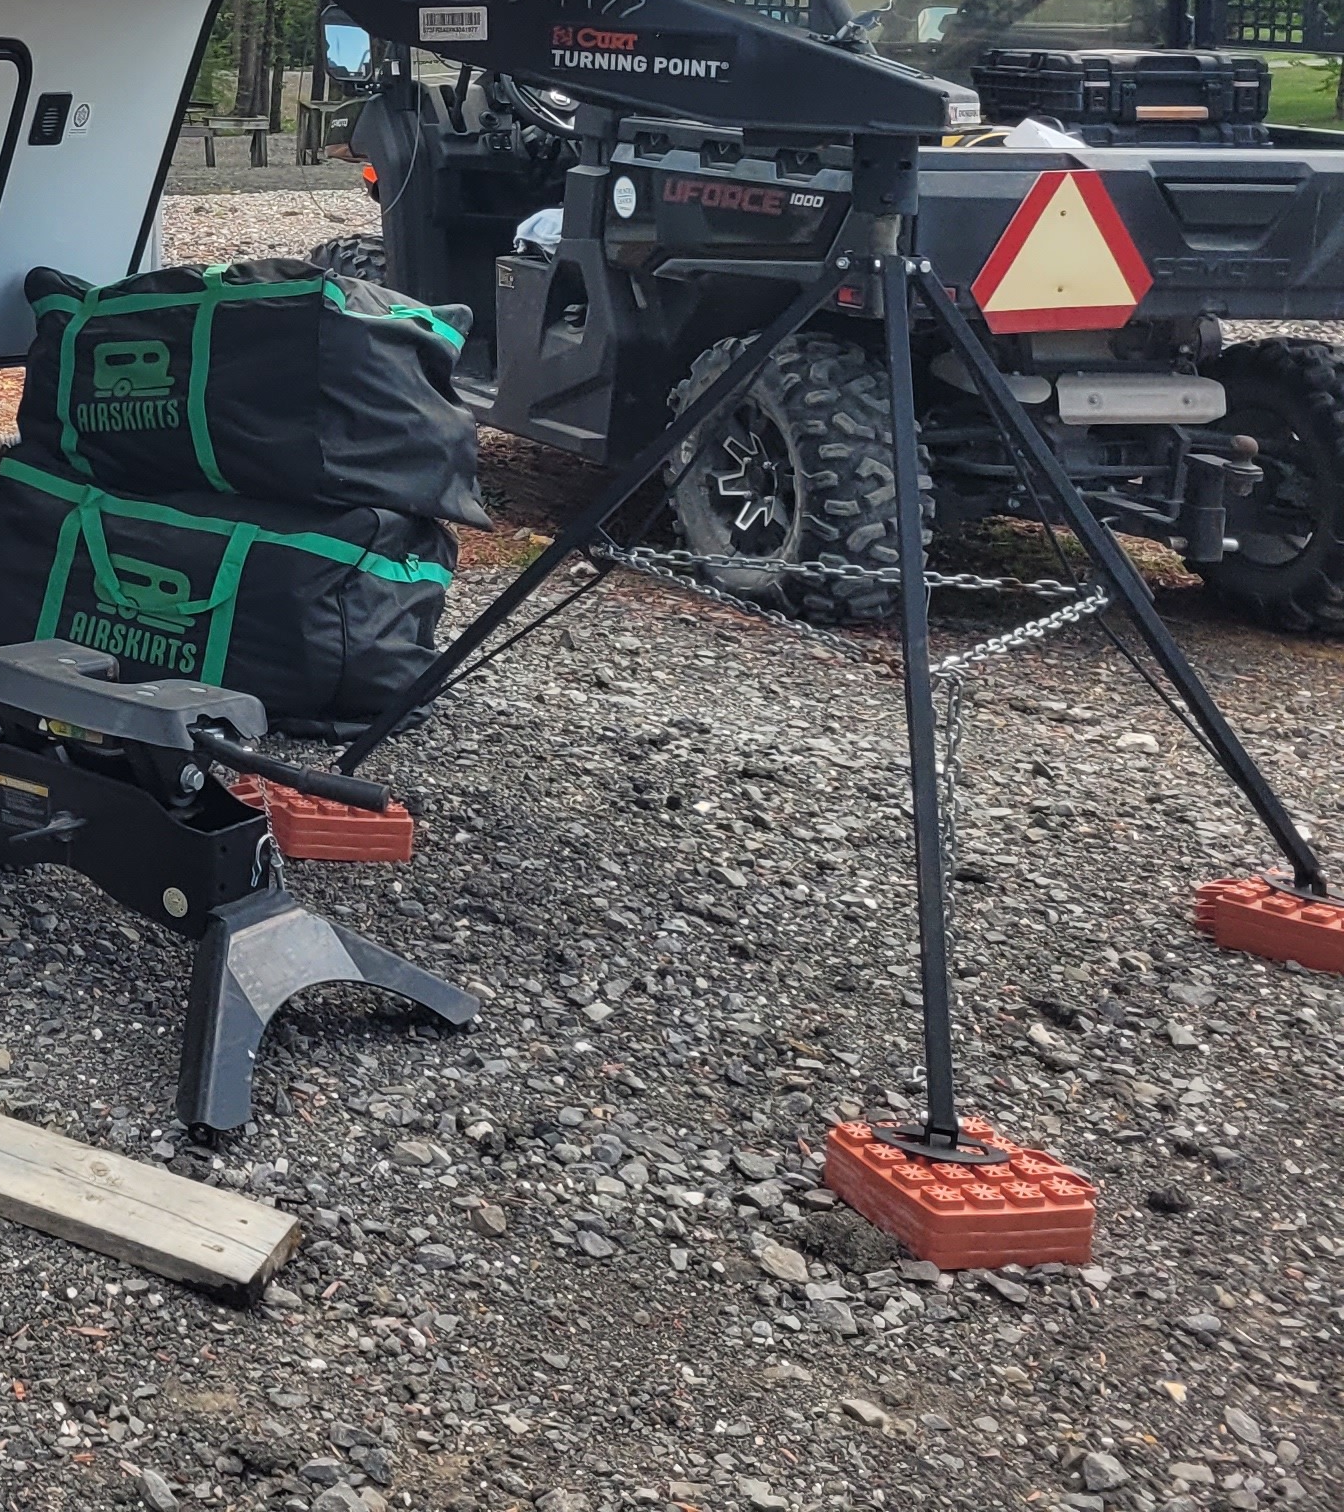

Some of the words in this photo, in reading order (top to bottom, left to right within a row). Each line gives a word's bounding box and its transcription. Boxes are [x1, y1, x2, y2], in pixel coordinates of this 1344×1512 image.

[576, 27, 639, 51] CURT
[551, 49, 647, 74] TURNING
[663, 178, 787, 215] UFORCE
[789, 192, 825, 208] 1000
[77, 399, 180, 433] AIRSKIRTS
[69, 611, 197, 674] AIRSKIRTS
